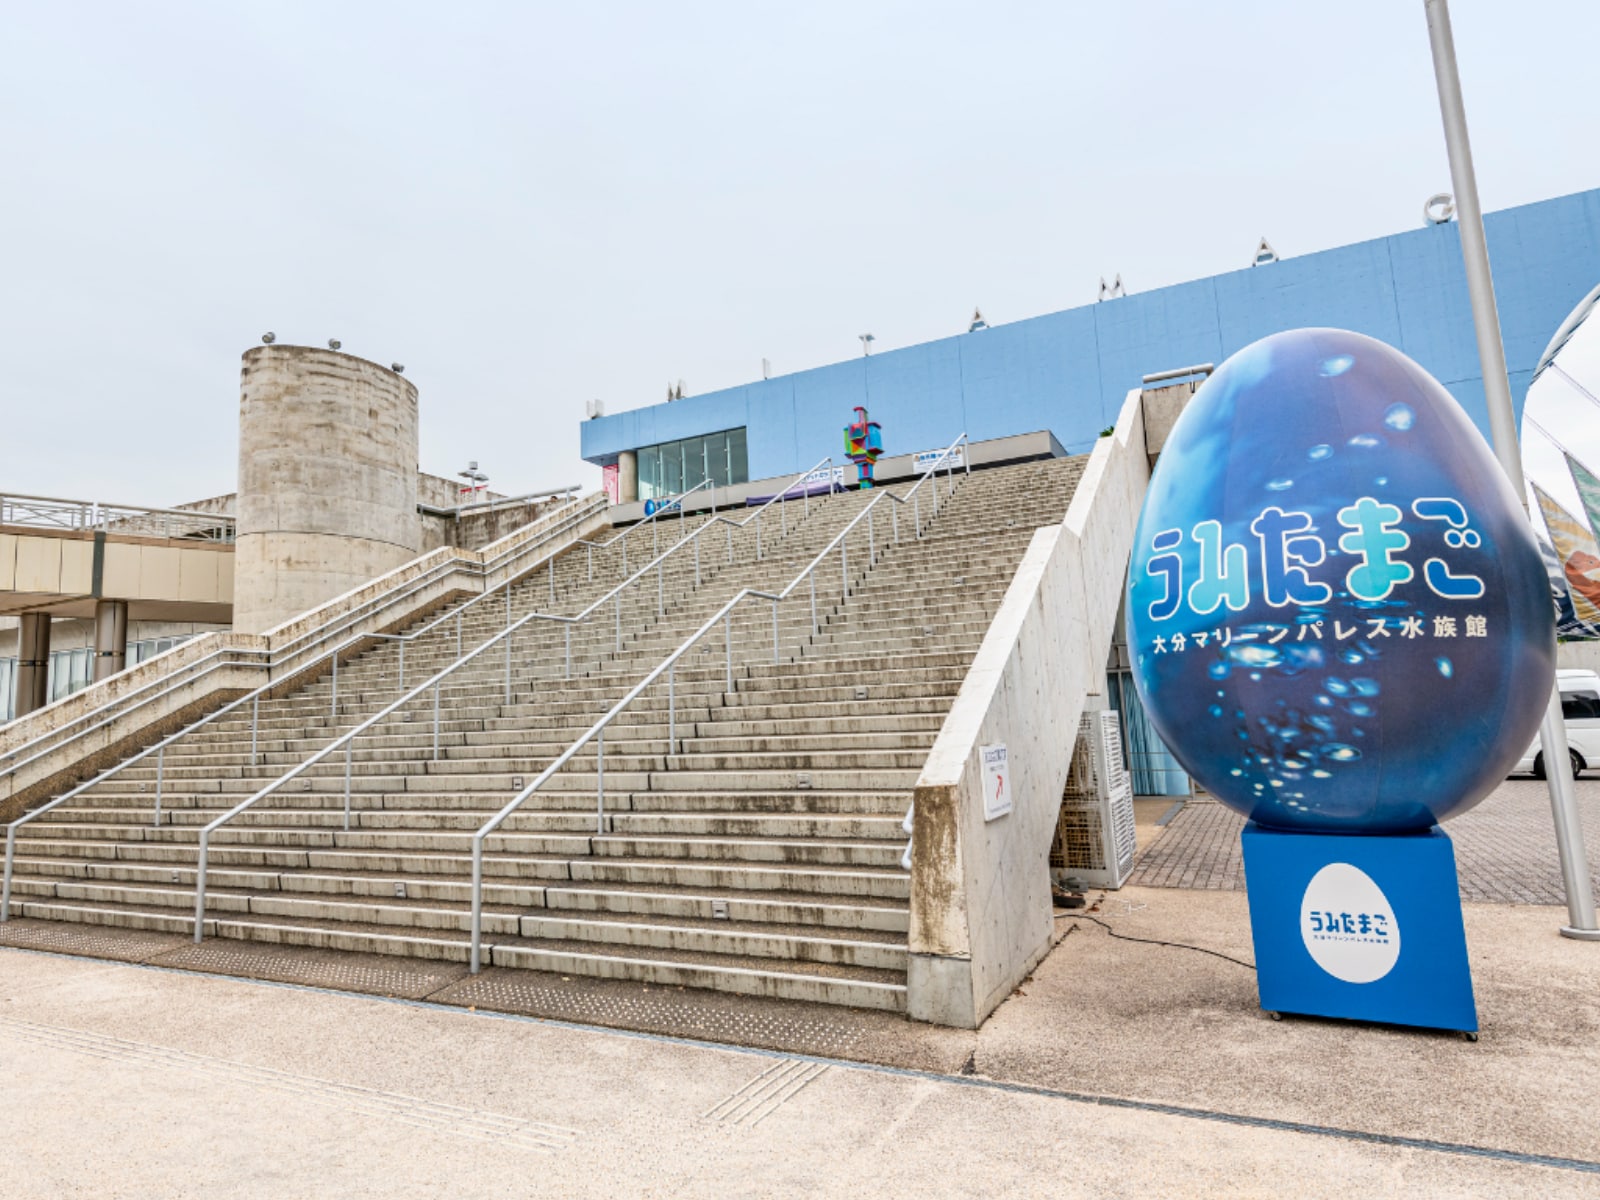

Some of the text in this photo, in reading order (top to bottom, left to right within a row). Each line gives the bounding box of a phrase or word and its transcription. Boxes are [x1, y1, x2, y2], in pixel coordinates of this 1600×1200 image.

[1147, 496, 1486, 622] うみたまご
[1152, 614, 1489, 656] 大分マリーンパレス水族館
[1309, 911, 1389, 937] うみたまご
